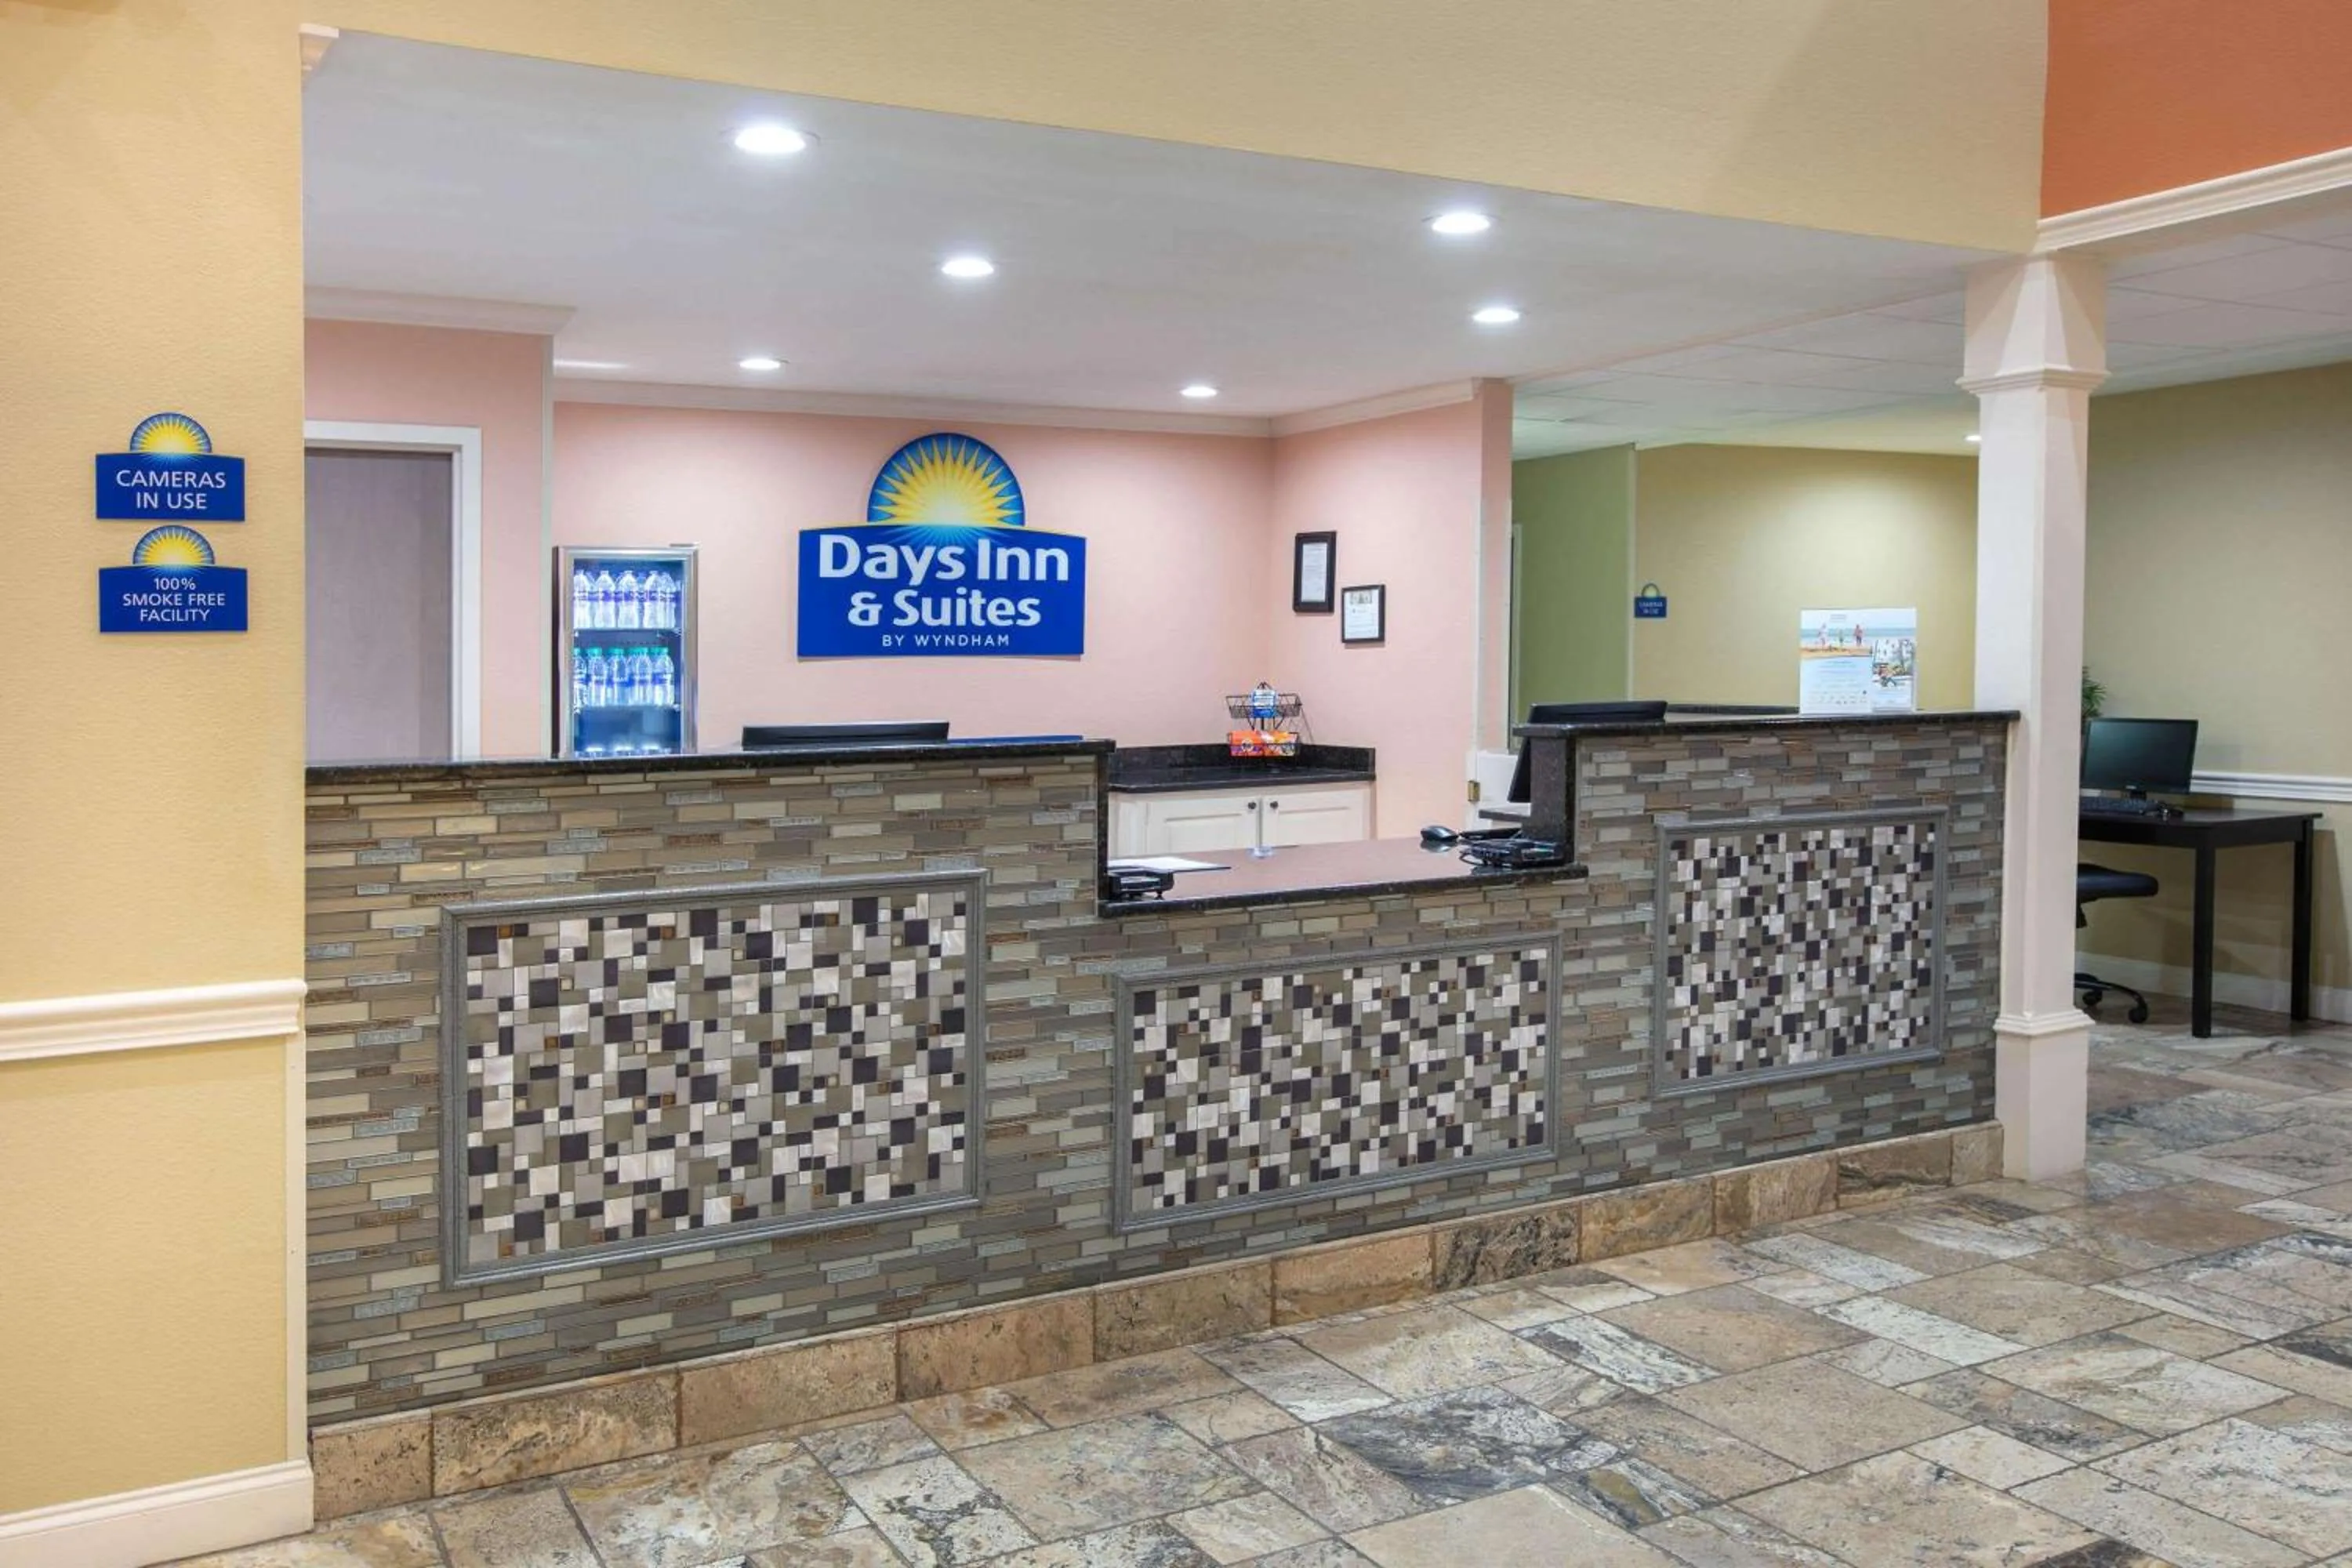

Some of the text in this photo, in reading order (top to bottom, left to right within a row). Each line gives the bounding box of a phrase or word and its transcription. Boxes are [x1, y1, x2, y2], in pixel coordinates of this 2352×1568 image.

[116, 470, 226, 488] CAMERAS
[136, 492, 207, 509] IN USE
[819, 534, 1068, 586] Days Inn
[154, 578, 196, 590] 100%
[123, 593, 225, 606] SMOKE FREE
[848, 587, 1041, 626] & Suites
[140, 609, 210, 621] FACILITY
[882, 635, 1009, 646] BY WYNDHAM
